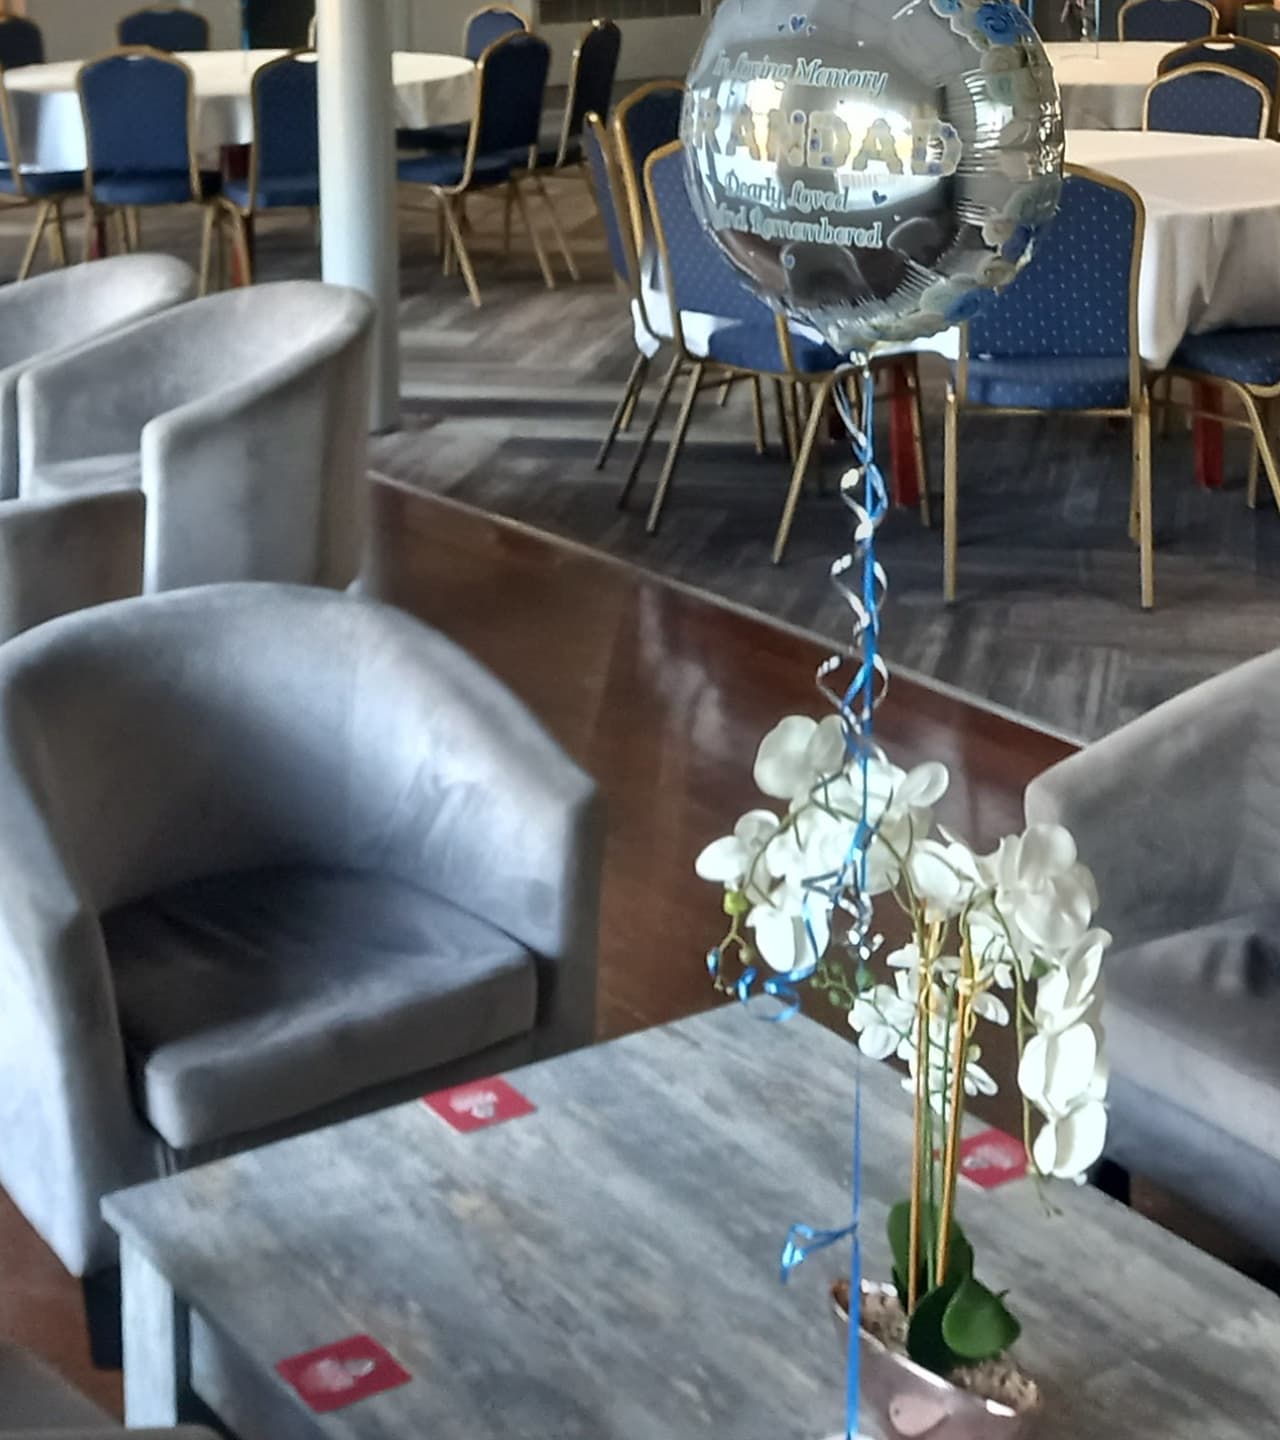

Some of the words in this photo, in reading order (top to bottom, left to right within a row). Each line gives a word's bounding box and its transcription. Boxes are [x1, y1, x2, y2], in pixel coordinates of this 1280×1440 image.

[793, 56, 889, 97] Memory
[724, 168, 787, 211] Dearly
[788, 179, 850, 213] Loved
[748, 206, 884, 249] Remembered
